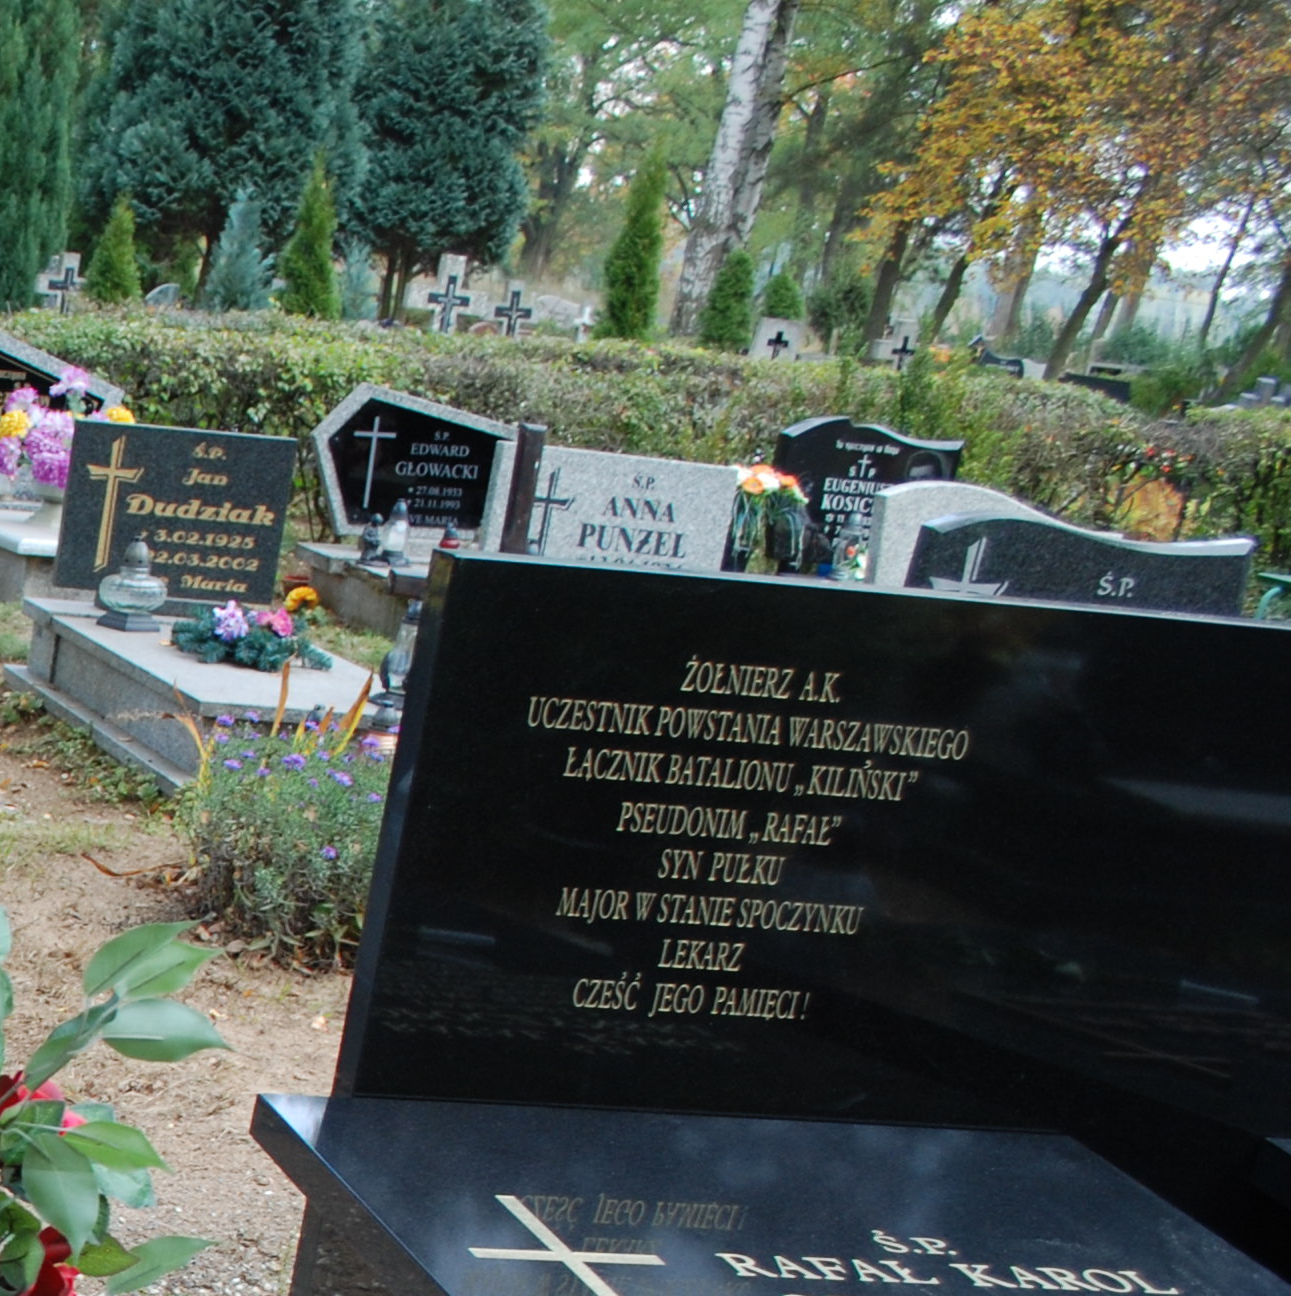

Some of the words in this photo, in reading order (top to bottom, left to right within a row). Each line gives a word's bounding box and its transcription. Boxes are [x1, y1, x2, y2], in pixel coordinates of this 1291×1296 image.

[411, 443, 470, 458] EDWARD
[182, 467, 229, 486] Jan
[395, 460, 479, 479] GŁOWACKI
[126, 493, 276, 526] Dudziak
[601, 496, 675, 523] ANNA
[154, 529, 256, 550] 3.02.1925
[180, 574, 248, 593] Maria
[1096, 571, 1135, 598] Ś.P.
[680, 654, 795, 700] ŻOŁNIERZ
[799, 670, 842, 703] A.K.
[526, 696, 654, 737] UCZESTNIK
[654, 706, 783, 746] POWSTANIA
[789, 716, 970, 761] WARSZAWSKIEGO
[563, 746, 665, 784] ŁĄCZNIK
[664, 753, 796, 793] BATALIONU
[616, 802, 747, 843] PSEUDONIM
[658, 848, 703, 880] SYN
[708, 851, 786, 886] PUŁKU
[555, 887, 629, 924] MAJOR
[635, 892, 657, 921] W
[656, 893, 735, 926] STANIE
[736, 898, 865, 935] SPOCZYNKU
[658, 938, 746, 972] LEKARZ
[572, 971, 642, 1011] CZEŚĆ
[648, 981, 706, 1018] JEGO
[871, 1229, 958, 1256] Ś.P.
[715, 1252, 941, 1285] RAFAŁ
[950, 1263, 1181, 1296] KAROL
